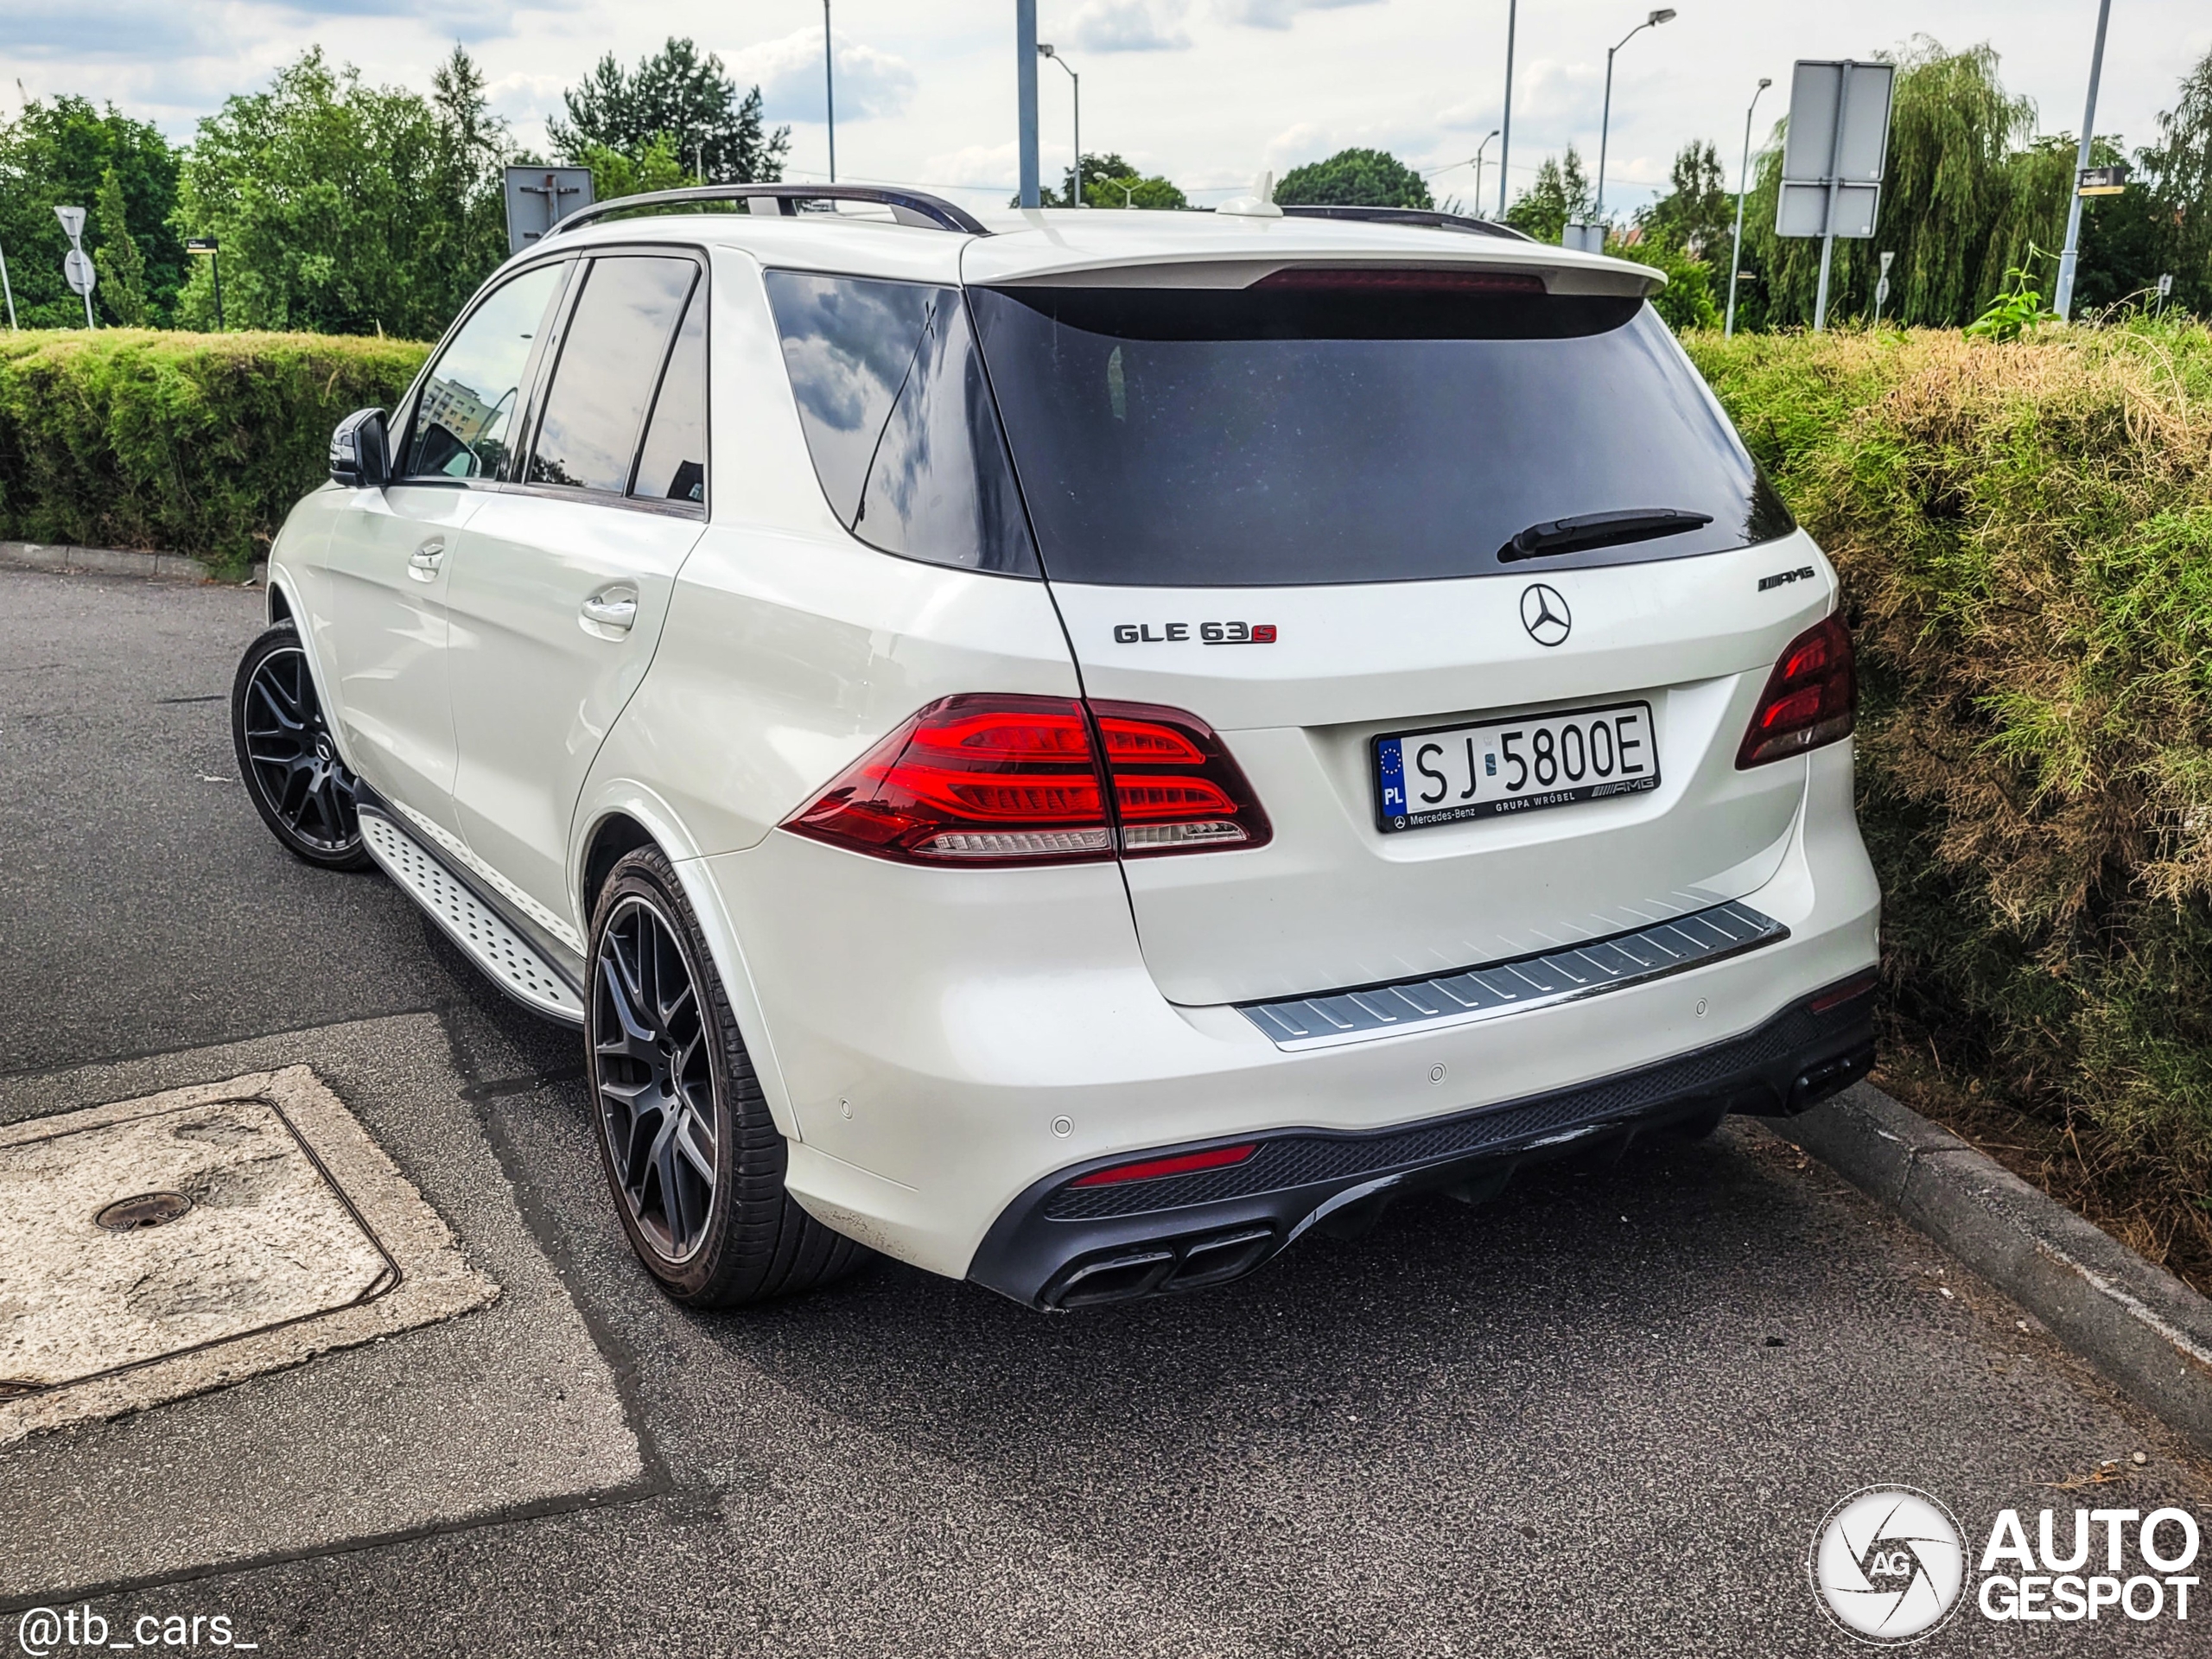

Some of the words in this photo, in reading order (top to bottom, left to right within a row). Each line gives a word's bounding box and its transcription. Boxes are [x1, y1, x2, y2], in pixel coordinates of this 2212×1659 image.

[1114, 622, 1191, 644] GLE
[1415, 737, 1477, 804] SJ
[1500, 714, 1644, 792] 5800E
[1384, 787, 1404, 805] PL
[1409, 807, 1476, 827] Mercedes-Benz
[1495, 799, 1530, 813] GRUPA
[1534, 791, 1576, 807] WRÓBEL
[1611, 778, 1655, 793] AMG
